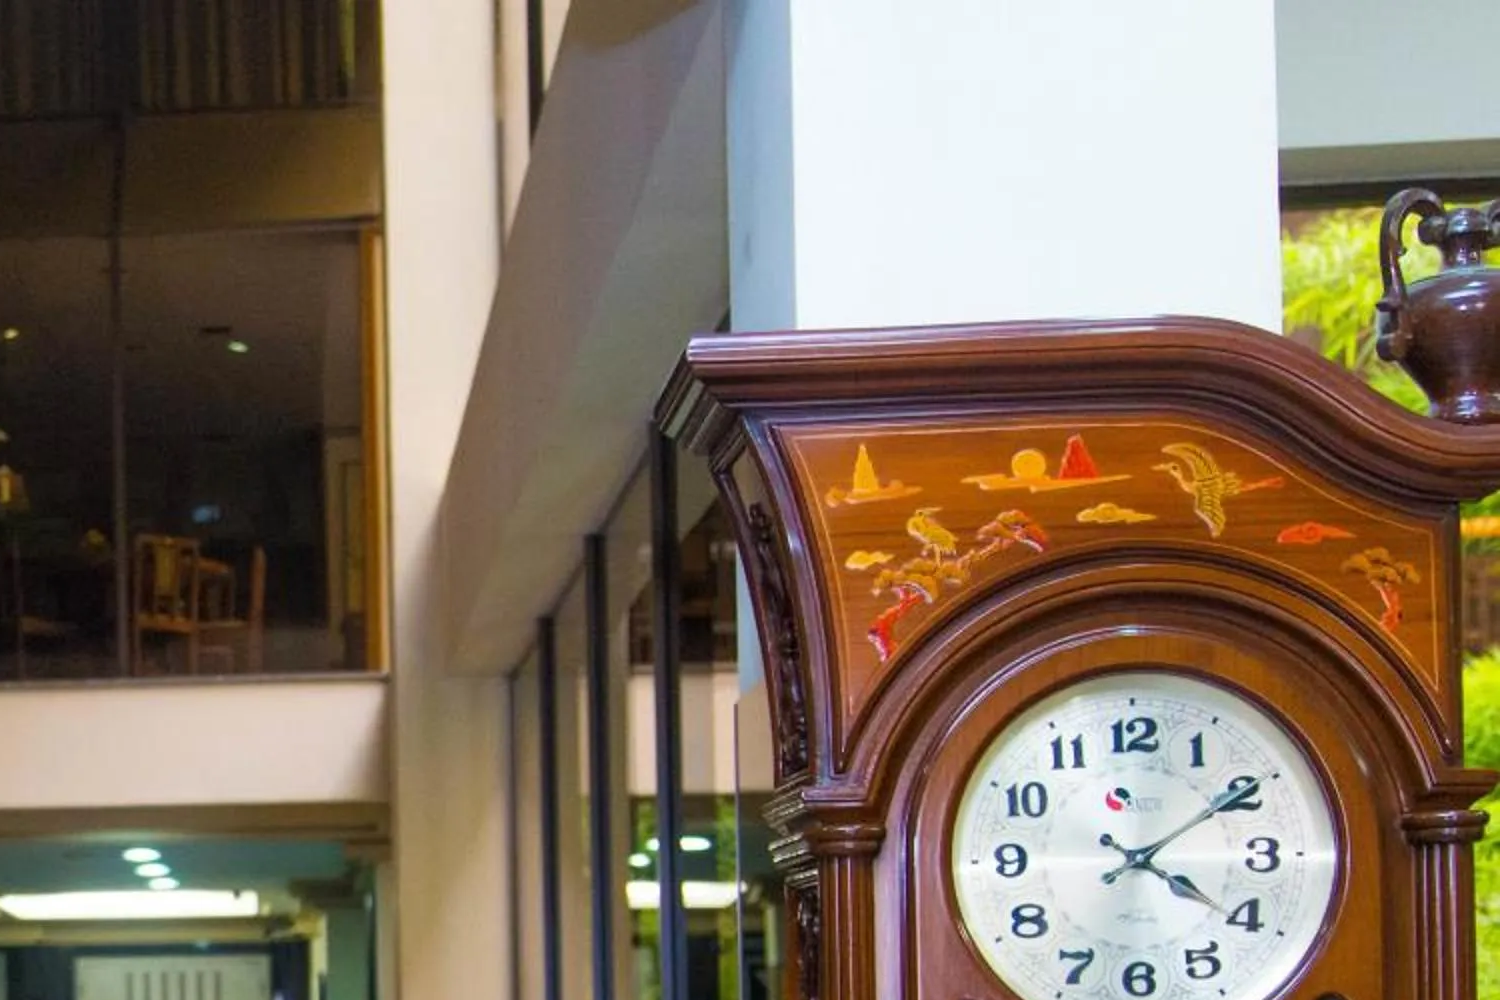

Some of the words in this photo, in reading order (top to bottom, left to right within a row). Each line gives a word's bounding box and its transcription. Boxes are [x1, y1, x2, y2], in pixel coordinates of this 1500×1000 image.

[1050, 733, 1086, 770] 11
[1111, 716, 1160, 754] 12
[1189, 731, 1205, 768] 1
[1006, 781, 1048, 818] 10
[1217, 775, 1263, 812] 2
[993, 843, 1028, 878] 9
[1244, 837, 1281, 873] 3
[1010, 903, 1049, 939] 8
[1225, 897, 1265, 933] 4
[1059, 947, 1096, 985] 7
[1184, 940, 1222, 979] 5
[1121, 961, 1157, 997] 6
